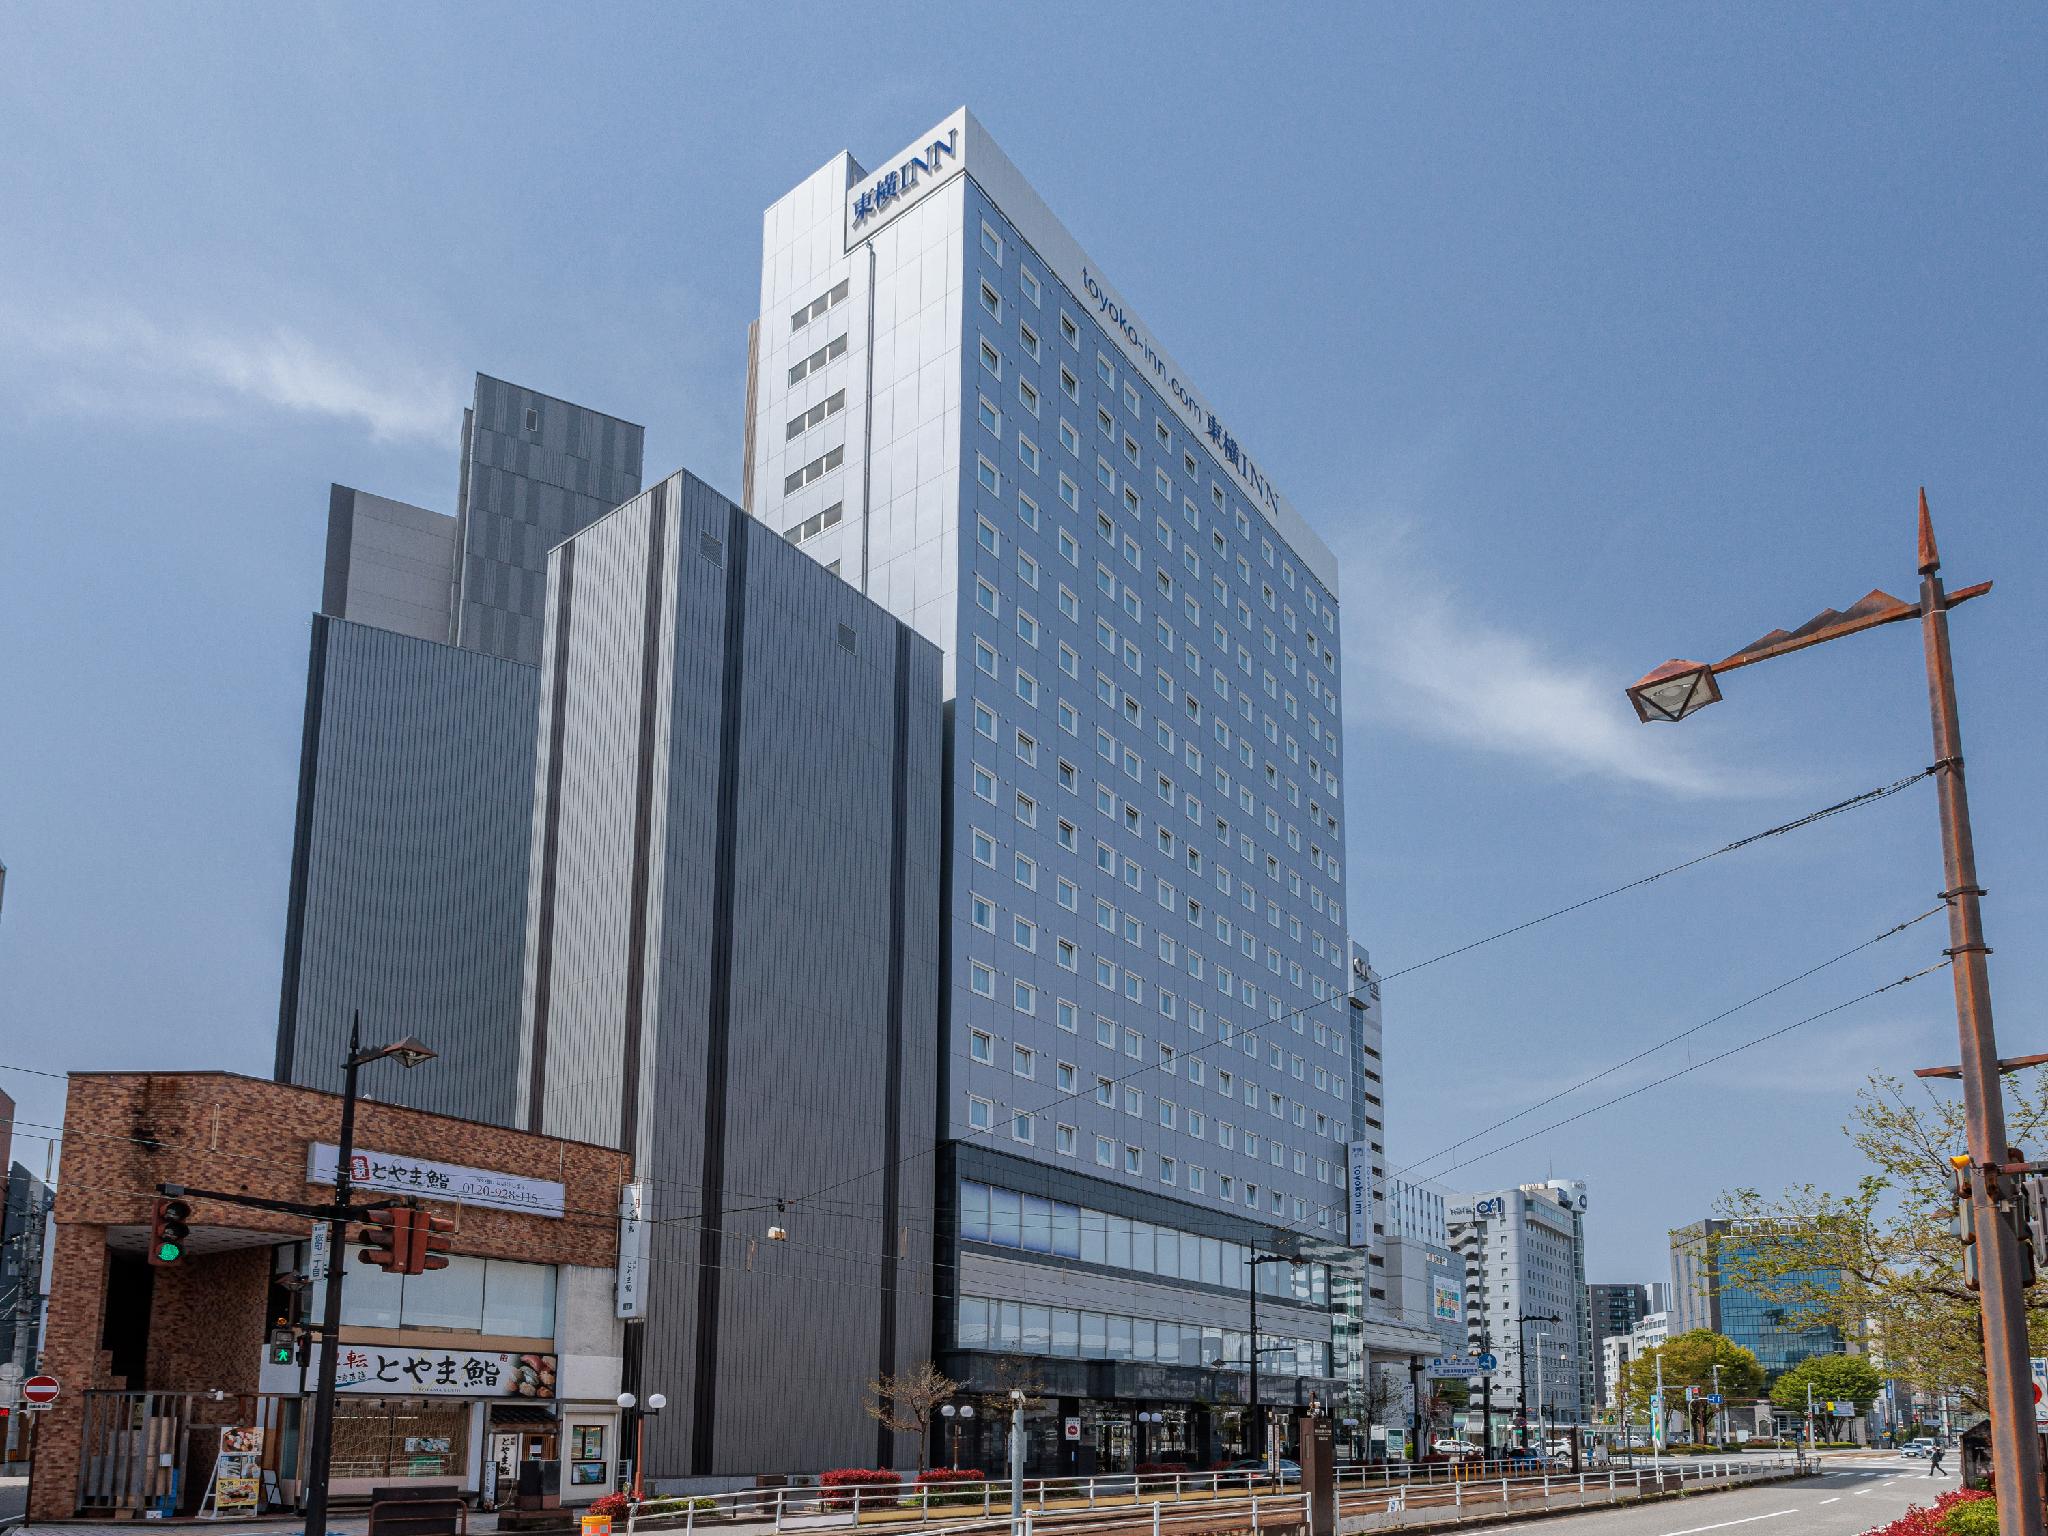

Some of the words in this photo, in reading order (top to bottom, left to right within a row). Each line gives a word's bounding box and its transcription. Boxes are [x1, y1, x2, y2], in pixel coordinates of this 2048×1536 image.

[852, 127, 959, 231] 東横INN
[1082, 266, 1202, 424] toyoko-inn.com
[1204, 410, 1280, 516] 東横INN
[372, 1161, 450, 1190] とやま鮨
[1353, 1164, 1364, 1198] toyoko
[376, 1354, 501, 1388] とやま鮨
